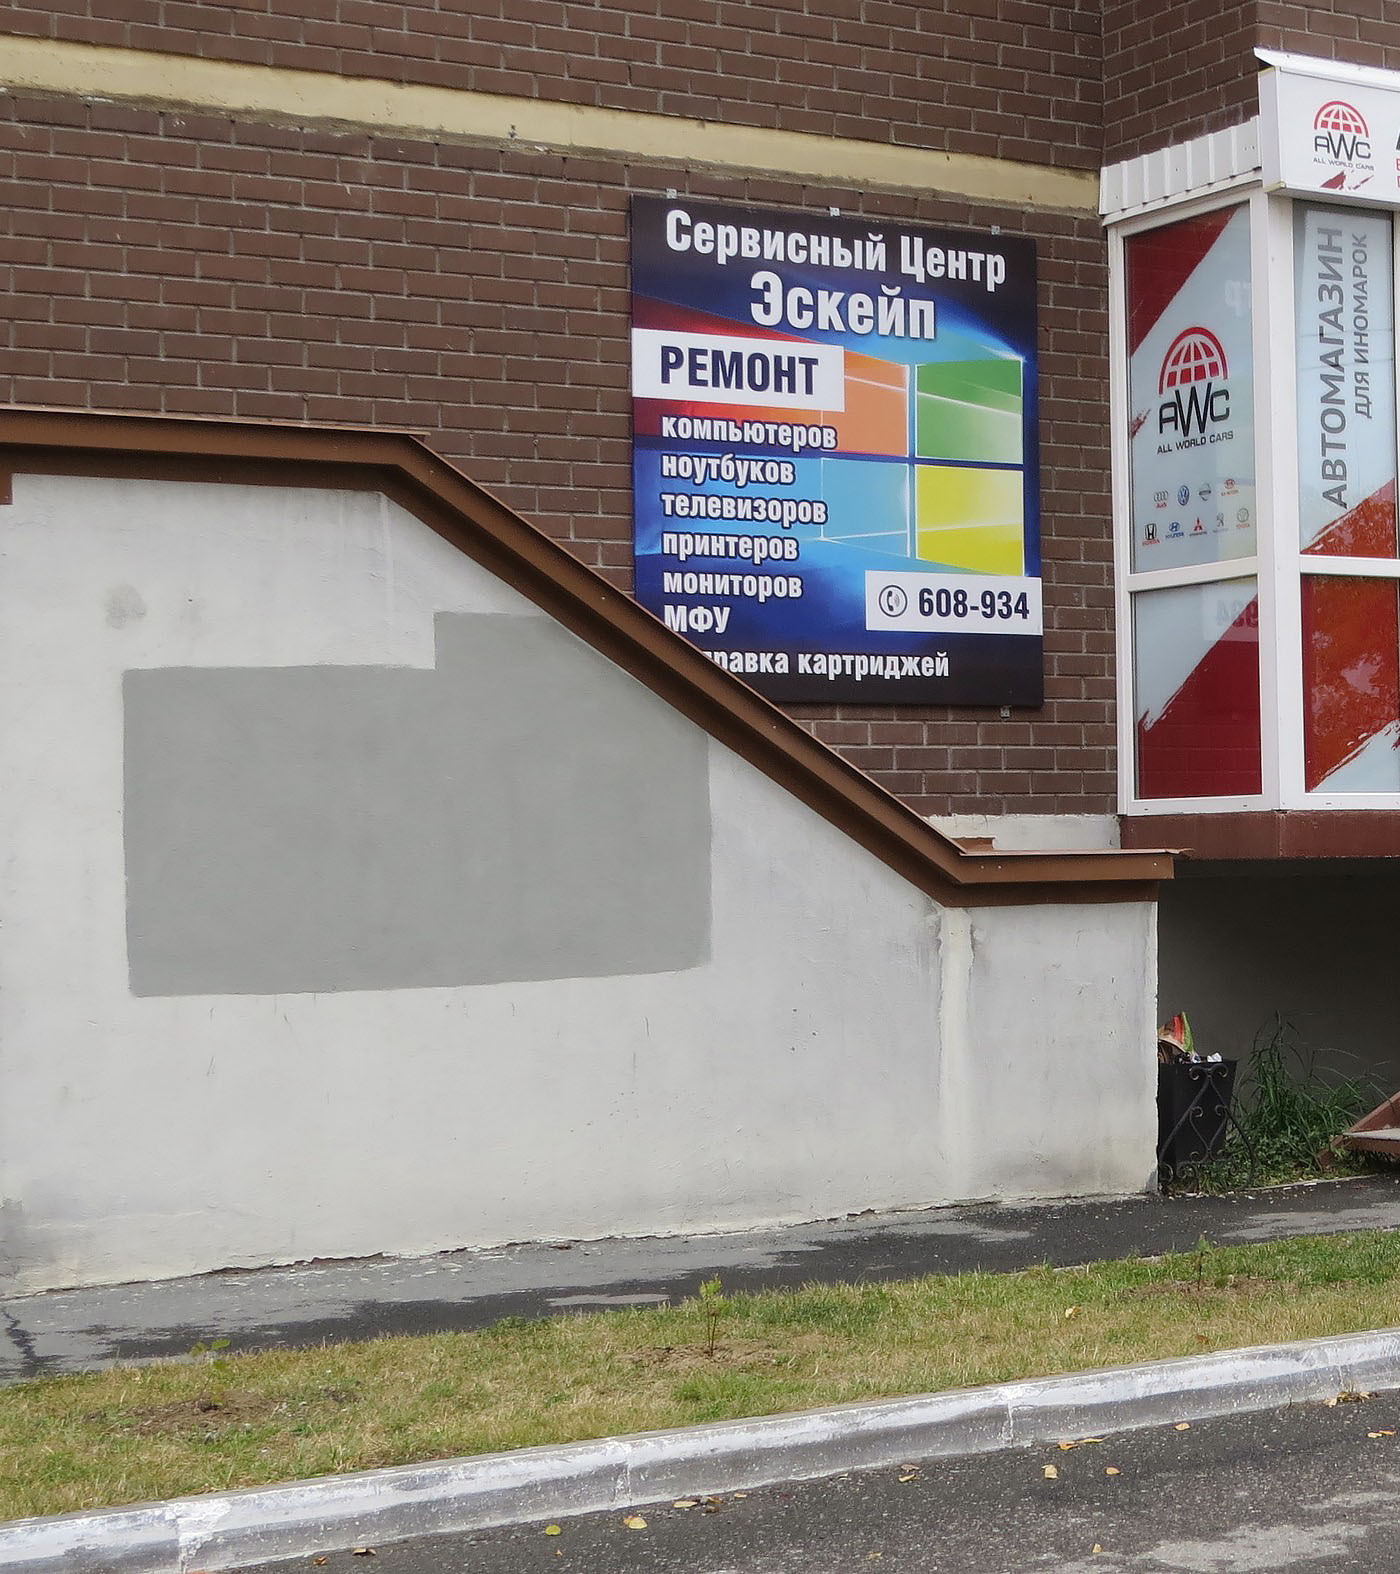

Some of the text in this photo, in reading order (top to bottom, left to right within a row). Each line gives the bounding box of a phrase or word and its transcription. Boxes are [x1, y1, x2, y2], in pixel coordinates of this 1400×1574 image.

[1314, 131, 1371, 161] AWC
[1328, 159, 1354, 168] WORLD
[666, 209, 1006, 291] Сервисный Центр
[750, 270, 935, 340] Эскейп
[1352, 233, 1372, 419] ДЛЯ ИНОМАРОК
[660, 344, 819, 396] РЕМОНТ
[1317, 227, 1348, 509] АВТОМАГАЗИН
[1159, 382, 1229, 437] AWC
[661, 415, 837, 451] компьютеров
[1157, 431, 1233, 455] ALL WORLD CARS
[661, 453, 795, 487] ноутбуков
[661, 492, 827, 526] телевизоров
[662, 532, 798, 562] принтеров
[663, 570, 803, 602] мониторов
[664, 604, 730, 634] МФУ
[918, 587, 1030, 620] 608-934
[797, 651, 950, 681] картриджей
